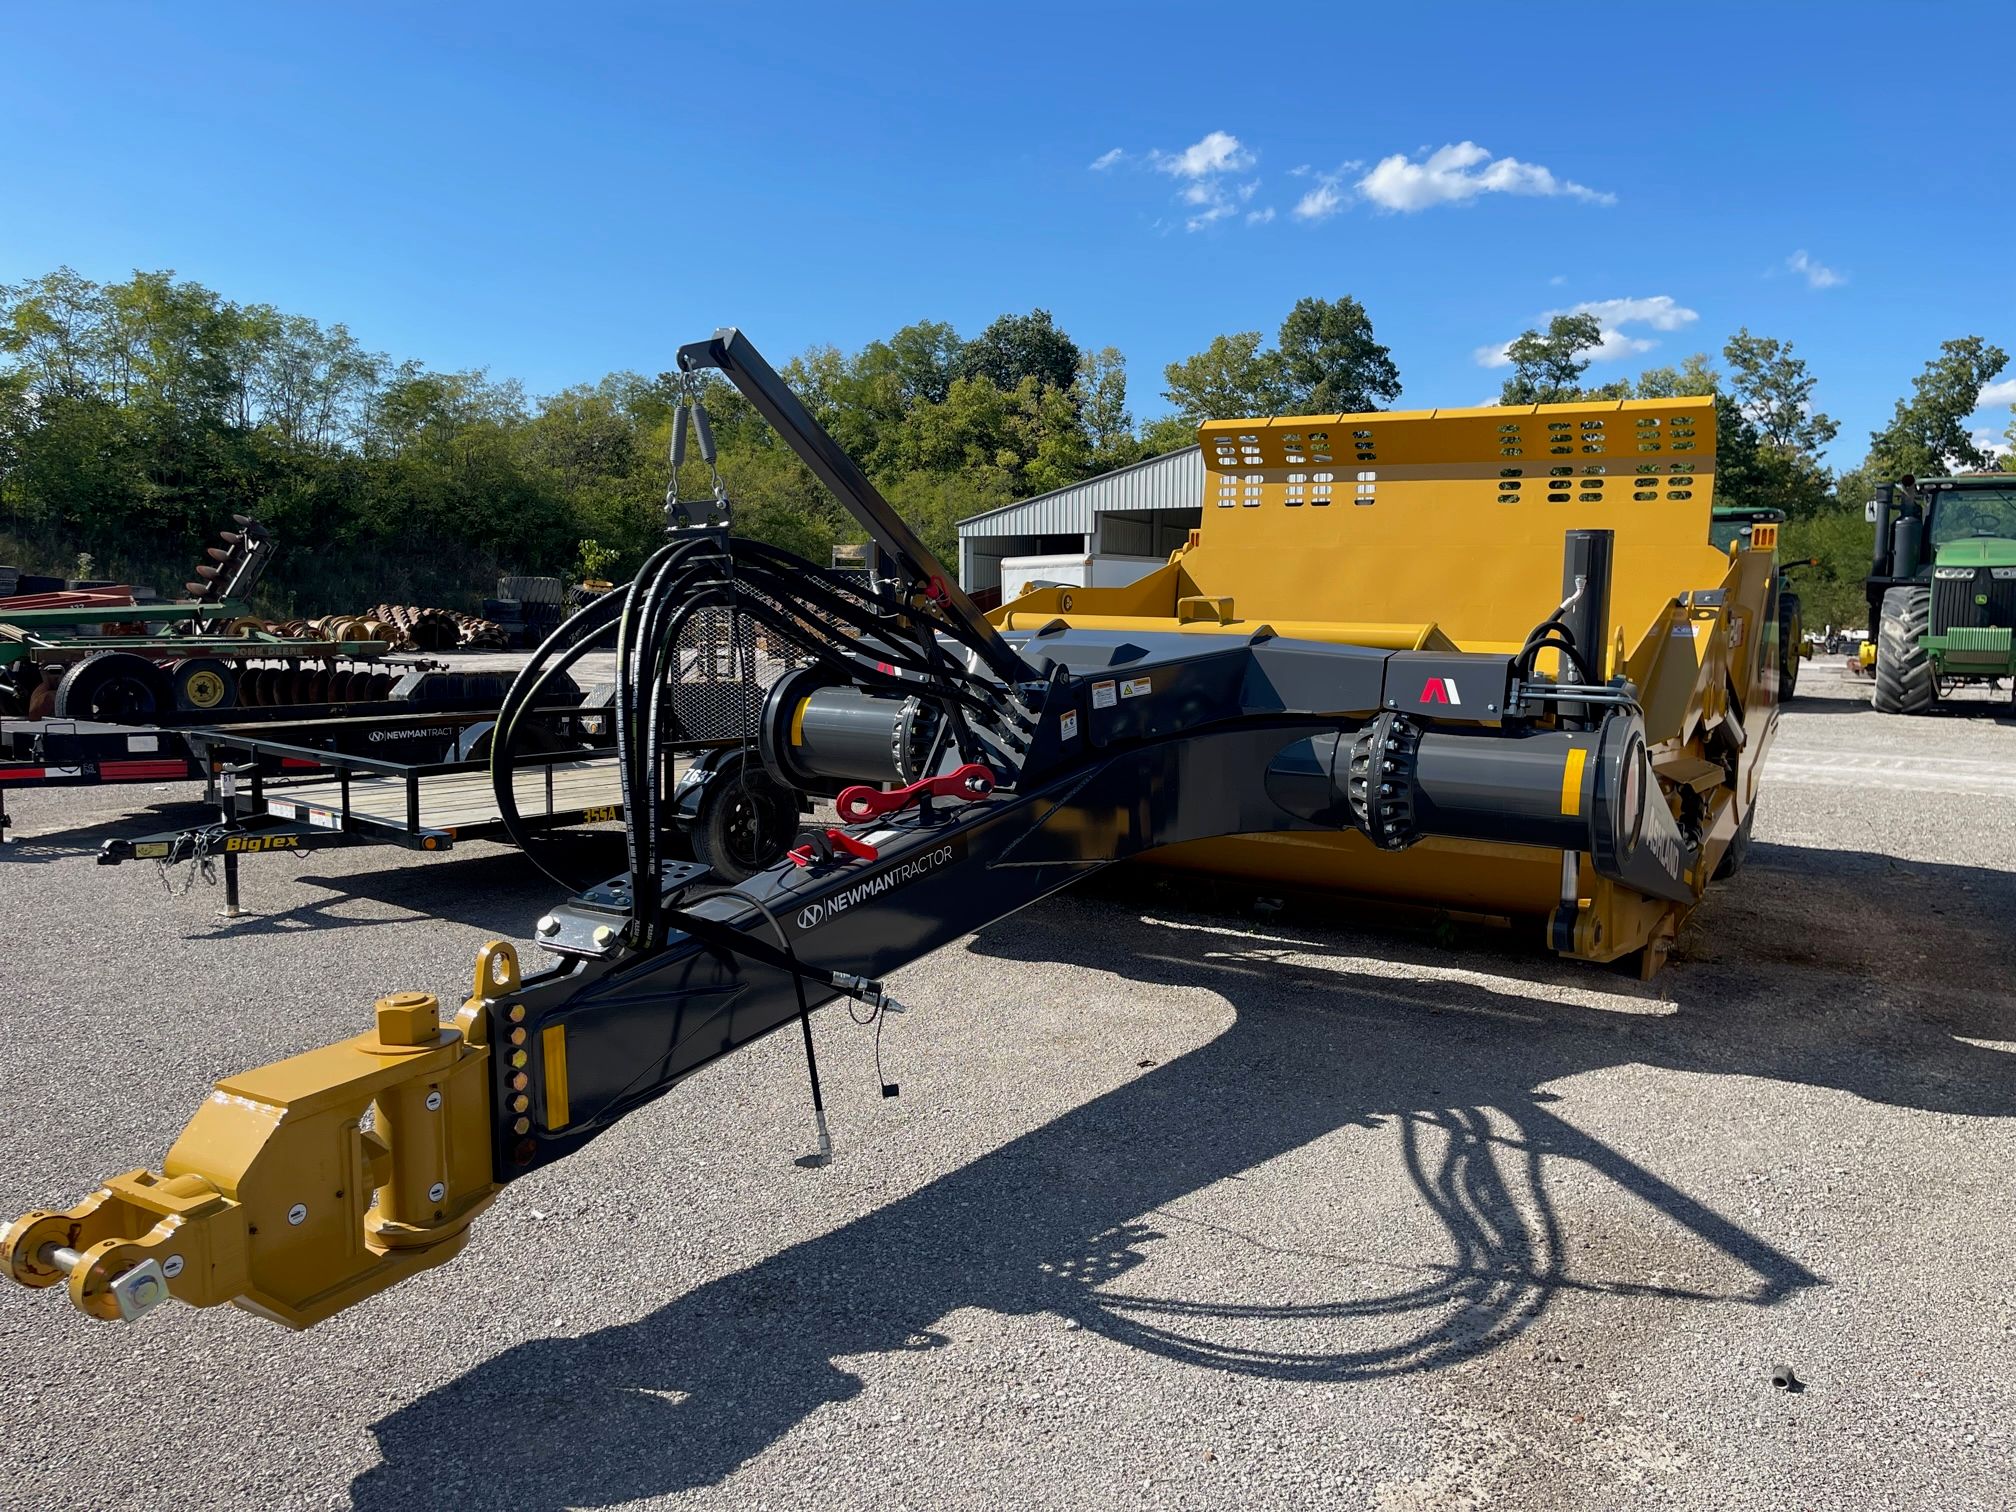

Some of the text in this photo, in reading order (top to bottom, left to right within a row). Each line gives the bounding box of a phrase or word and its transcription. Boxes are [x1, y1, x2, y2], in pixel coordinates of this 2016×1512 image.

[683, 768, 717, 784] 7637
[582, 805, 617, 823] 355A
[226, 835, 299, 852] BigTex
[1646, 805, 1679, 881] ASHLAND
[827, 845, 953, 916] NEWMANTRACTOR
